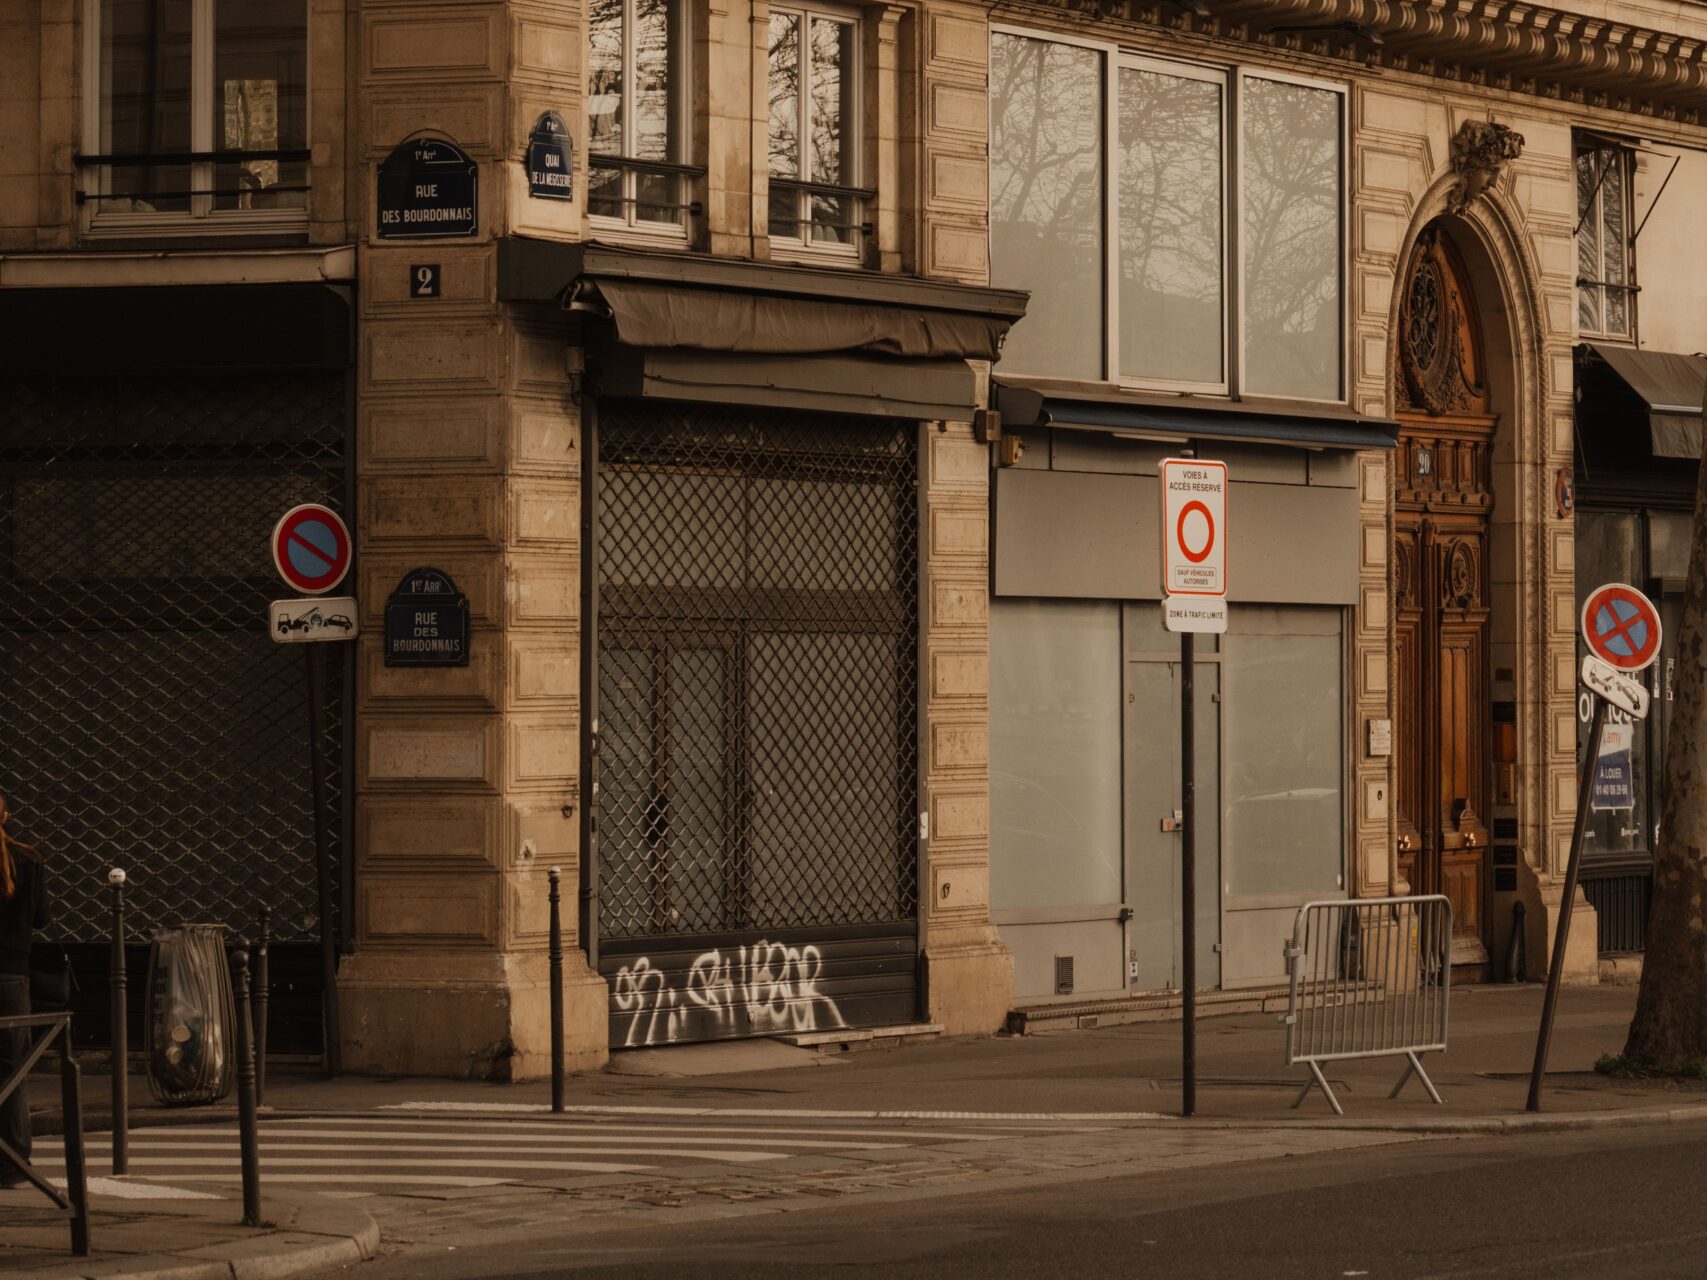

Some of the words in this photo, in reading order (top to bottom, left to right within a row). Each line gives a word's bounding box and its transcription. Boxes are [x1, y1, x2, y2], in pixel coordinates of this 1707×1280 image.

[545, 153, 560, 168] QUAI
[532, 171, 538, 184] DE
[539, 172, 546, 185] LA
[415, 184, 438, 198] RUE
[382, 210, 400, 224] DES
[404, 207, 472, 223] BOURDONNAIS
[417, 267, 432, 295] 2
[1419, 453, 1430, 474] 20
[1183, 470, 1202, 480] VOIES
[415, 612, 438, 625] RUE
[1170, 610, 1183, 618] ZONE
[414, 628, 439, 637] DES
[393, 639, 461, 652] BOURDONNAIS
[1605, 768, 1622, 779] LOUER
